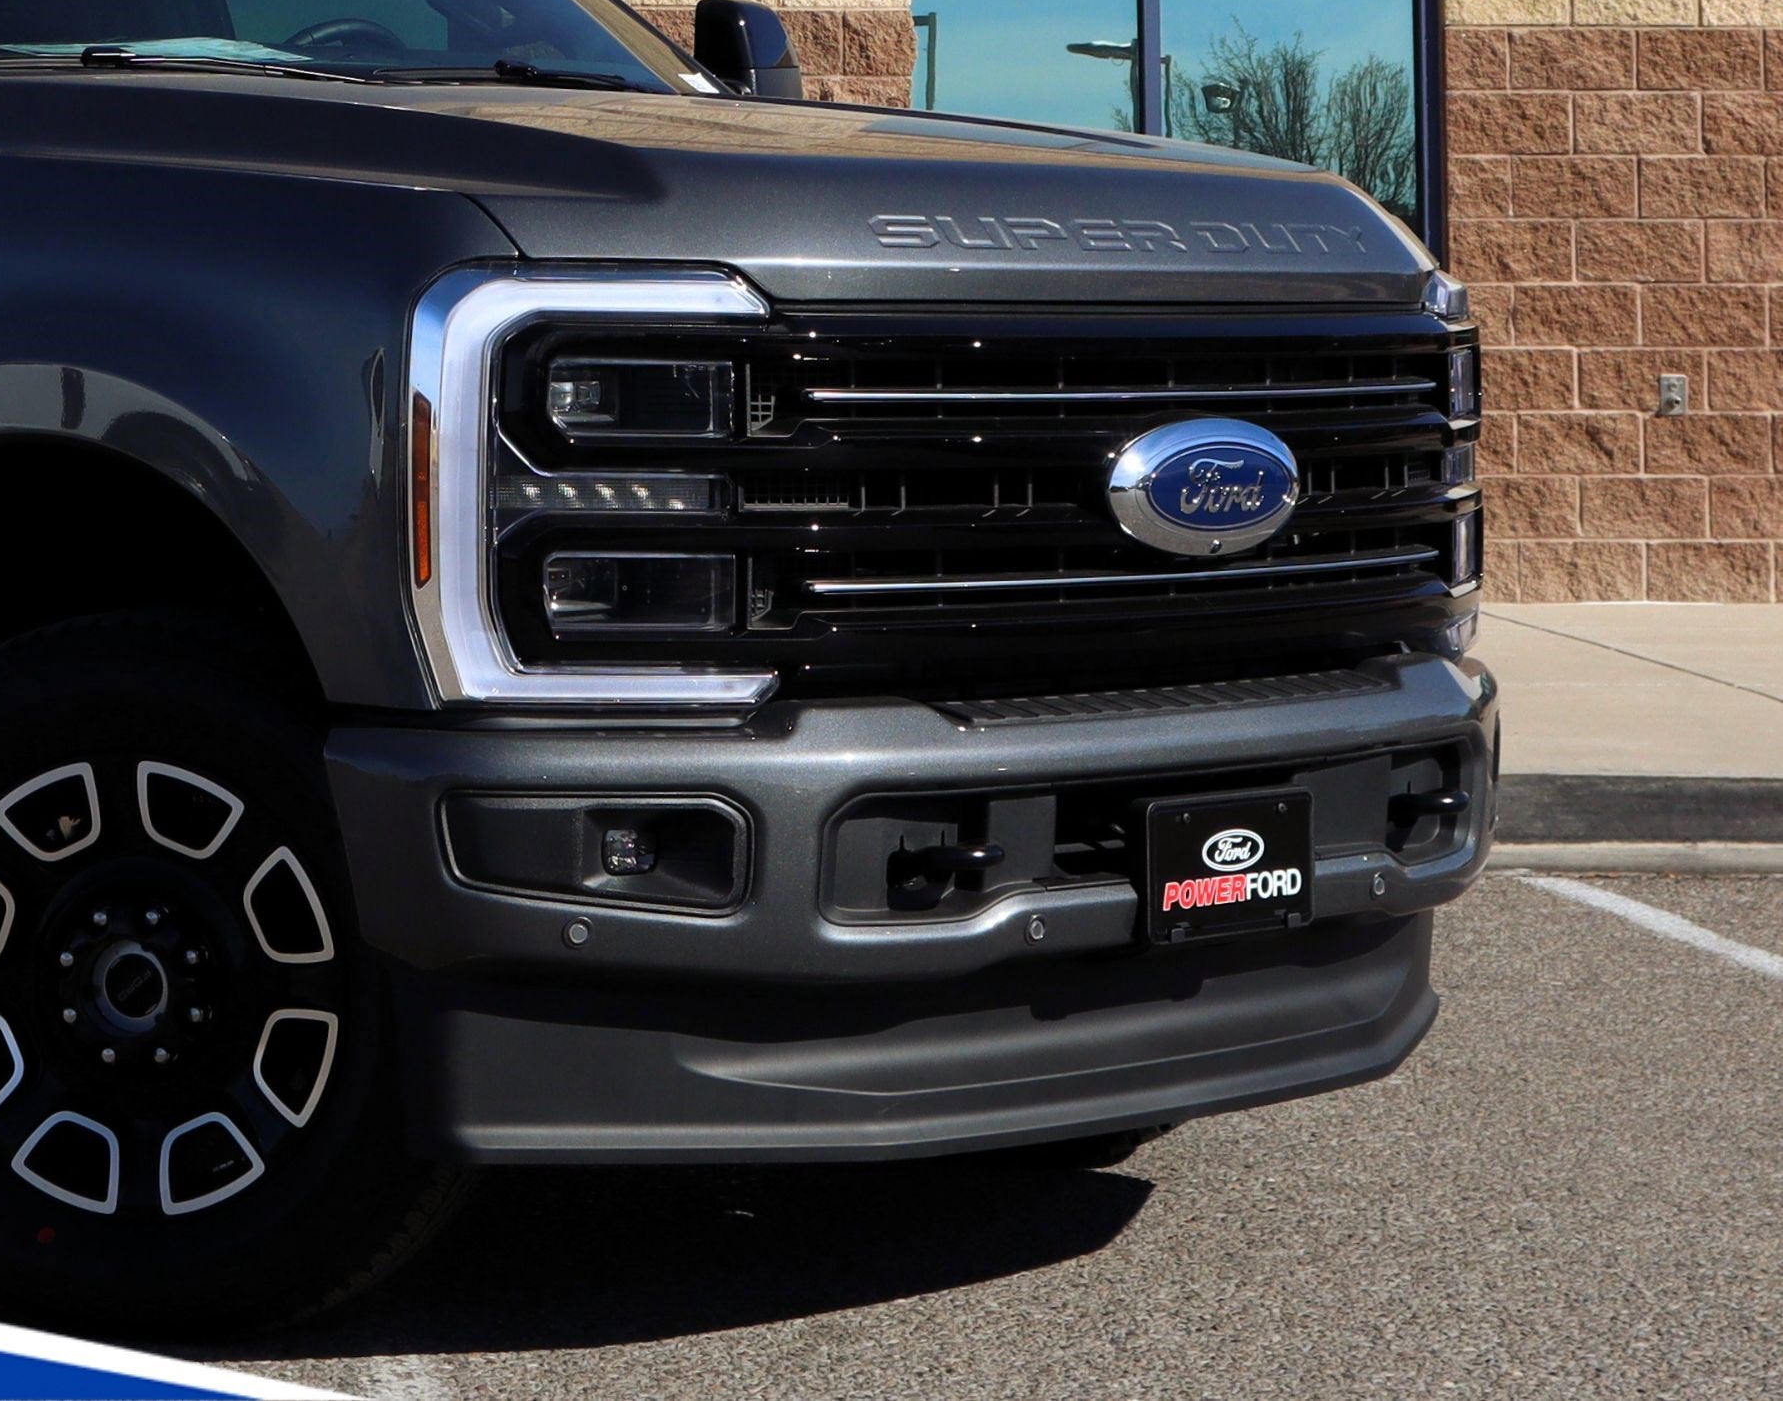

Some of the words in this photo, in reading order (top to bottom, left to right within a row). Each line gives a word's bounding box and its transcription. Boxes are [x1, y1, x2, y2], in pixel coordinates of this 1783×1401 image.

[867, 214, 1189, 254] SUPER
[1190, 220, 1367, 255] DUTY
[1179, 457, 1265, 515] Ford
[1214, 837, 1252, 863] Ford
[1162, 868, 1302, 912] POWERFORD
